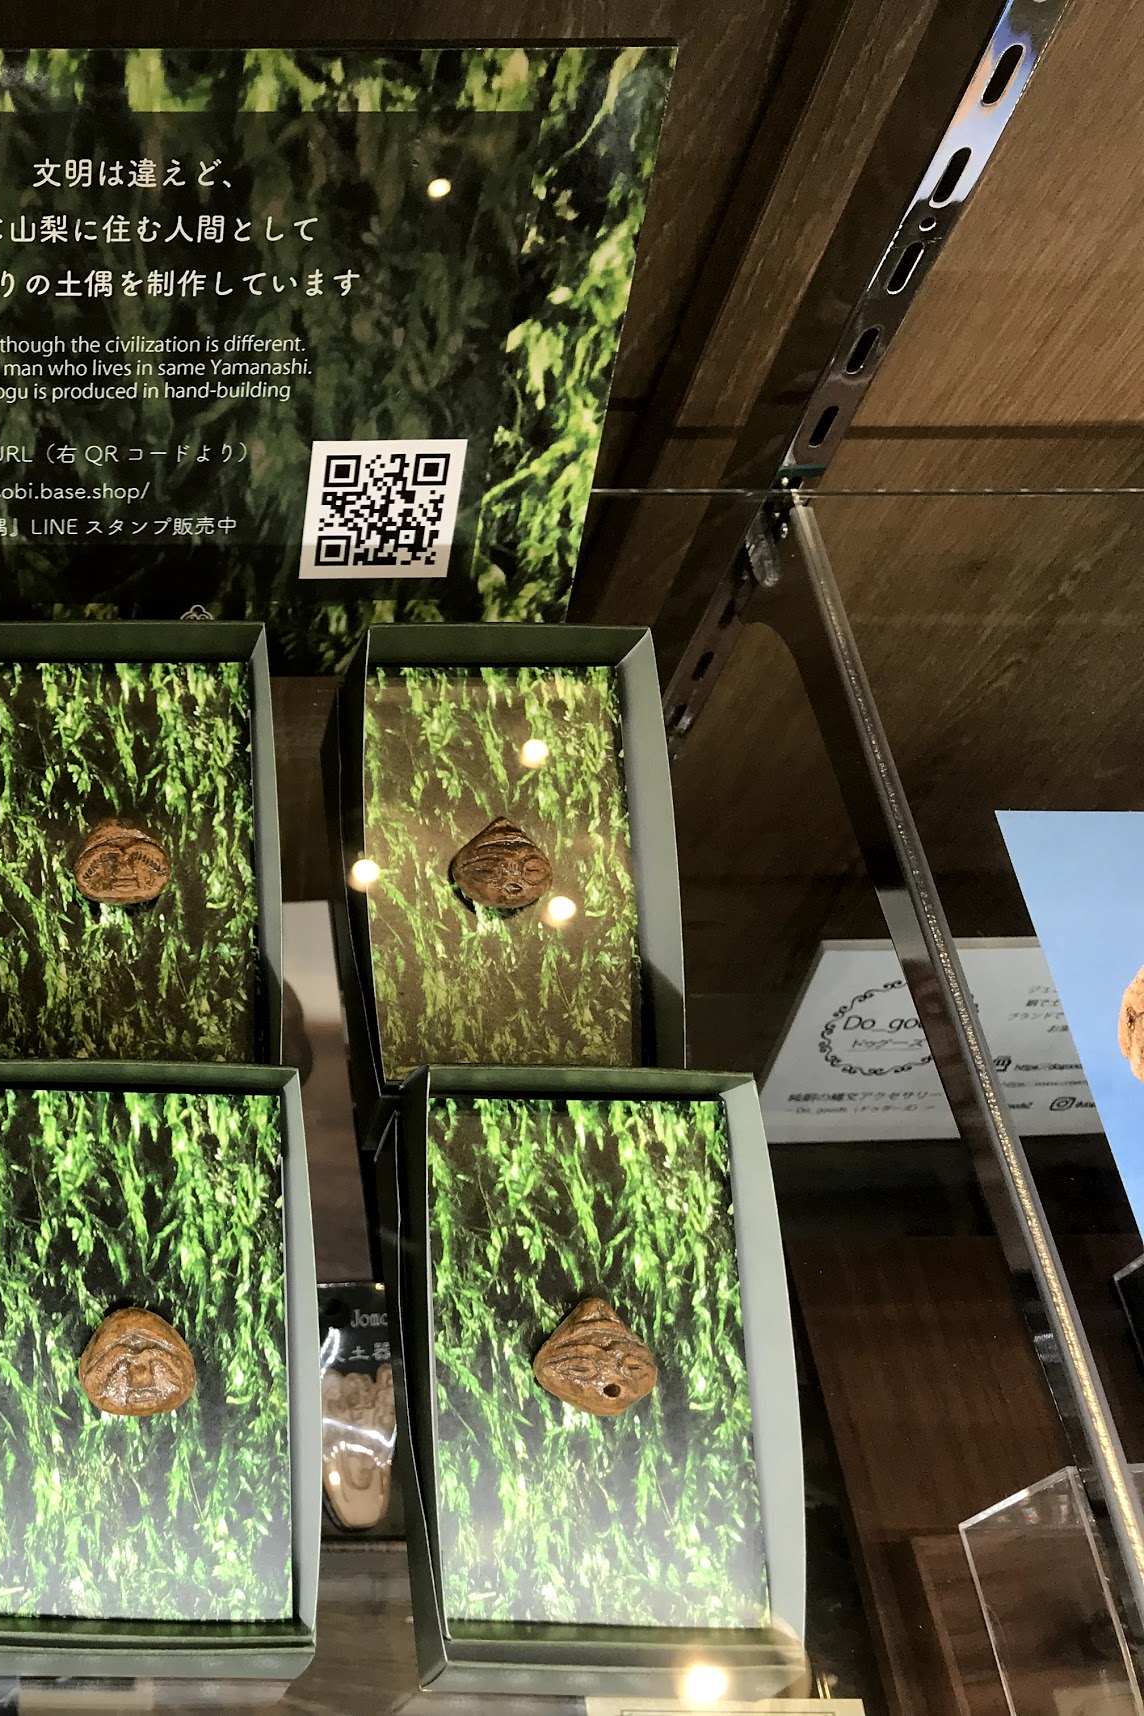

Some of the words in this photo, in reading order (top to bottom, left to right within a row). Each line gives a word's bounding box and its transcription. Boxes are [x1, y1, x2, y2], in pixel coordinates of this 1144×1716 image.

[32, 157, 233, 189] 文明は違えど、
[0, 335, 65, 358] though
[70, 335, 101, 354] the
[105, 335, 201, 353] civilization
[205, 335, 219, 353] is
[223, 334, 306, 353] different.
[3, 363, 43, 377] man
[47, 359, 88, 377] who
[92, 359, 132, 377] lives
[136, 359, 153, 376] in
[157, 362, 206, 376] same
[210, 357, 312, 376] Yamanashi.
[33, 382, 47, 400] is
[51, 381, 138, 403] produced
[143, 382, 159, 399] in
[164, 380, 291, 402] hand-building
